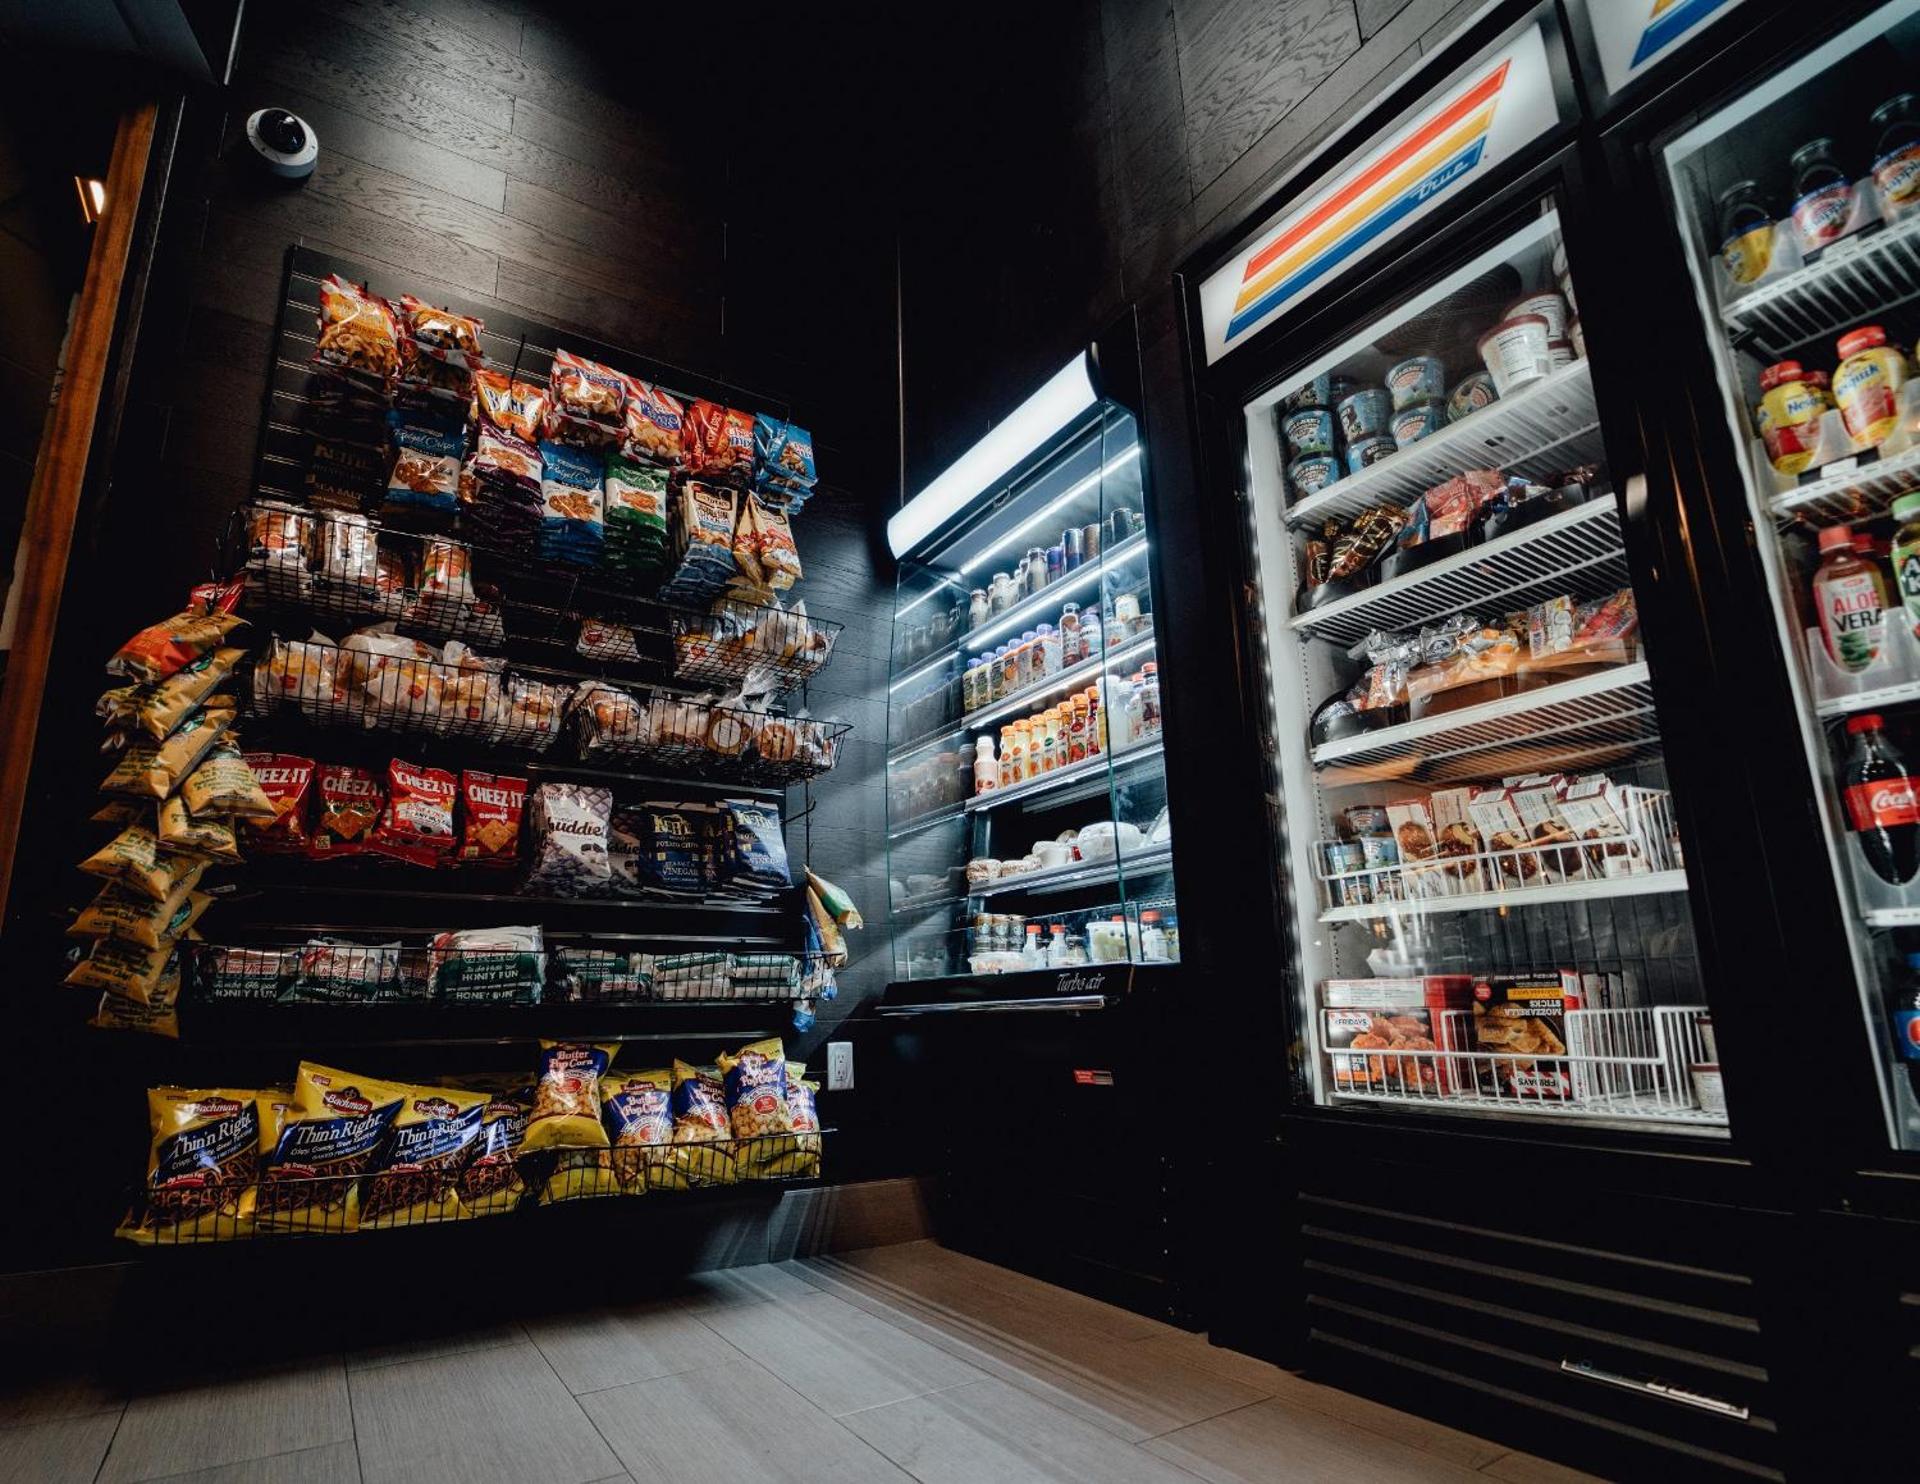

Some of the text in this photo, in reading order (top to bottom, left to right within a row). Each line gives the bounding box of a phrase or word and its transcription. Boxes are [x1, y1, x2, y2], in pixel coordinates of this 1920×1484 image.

[1834, 590, 1882, 616] ALOE
[1833, 607, 1884, 633] VERA
[467, 783, 523, 809] CHEEZ-IT
[1085, 972, 1106, 991] air
[1504, 1008, 1563, 1016] MOZZARELLA
[1529, 1000, 1562, 1008] STICKS
[556, 1050, 590, 1061] Butter
[569, 1058, 595, 1068] Corn
[326, 1094, 368, 1112] Bachman
[217, 1110, 253, 1141] Right
[341, 1112, 384, 1139] Right
[436, 1115, 467, 1138] Right
